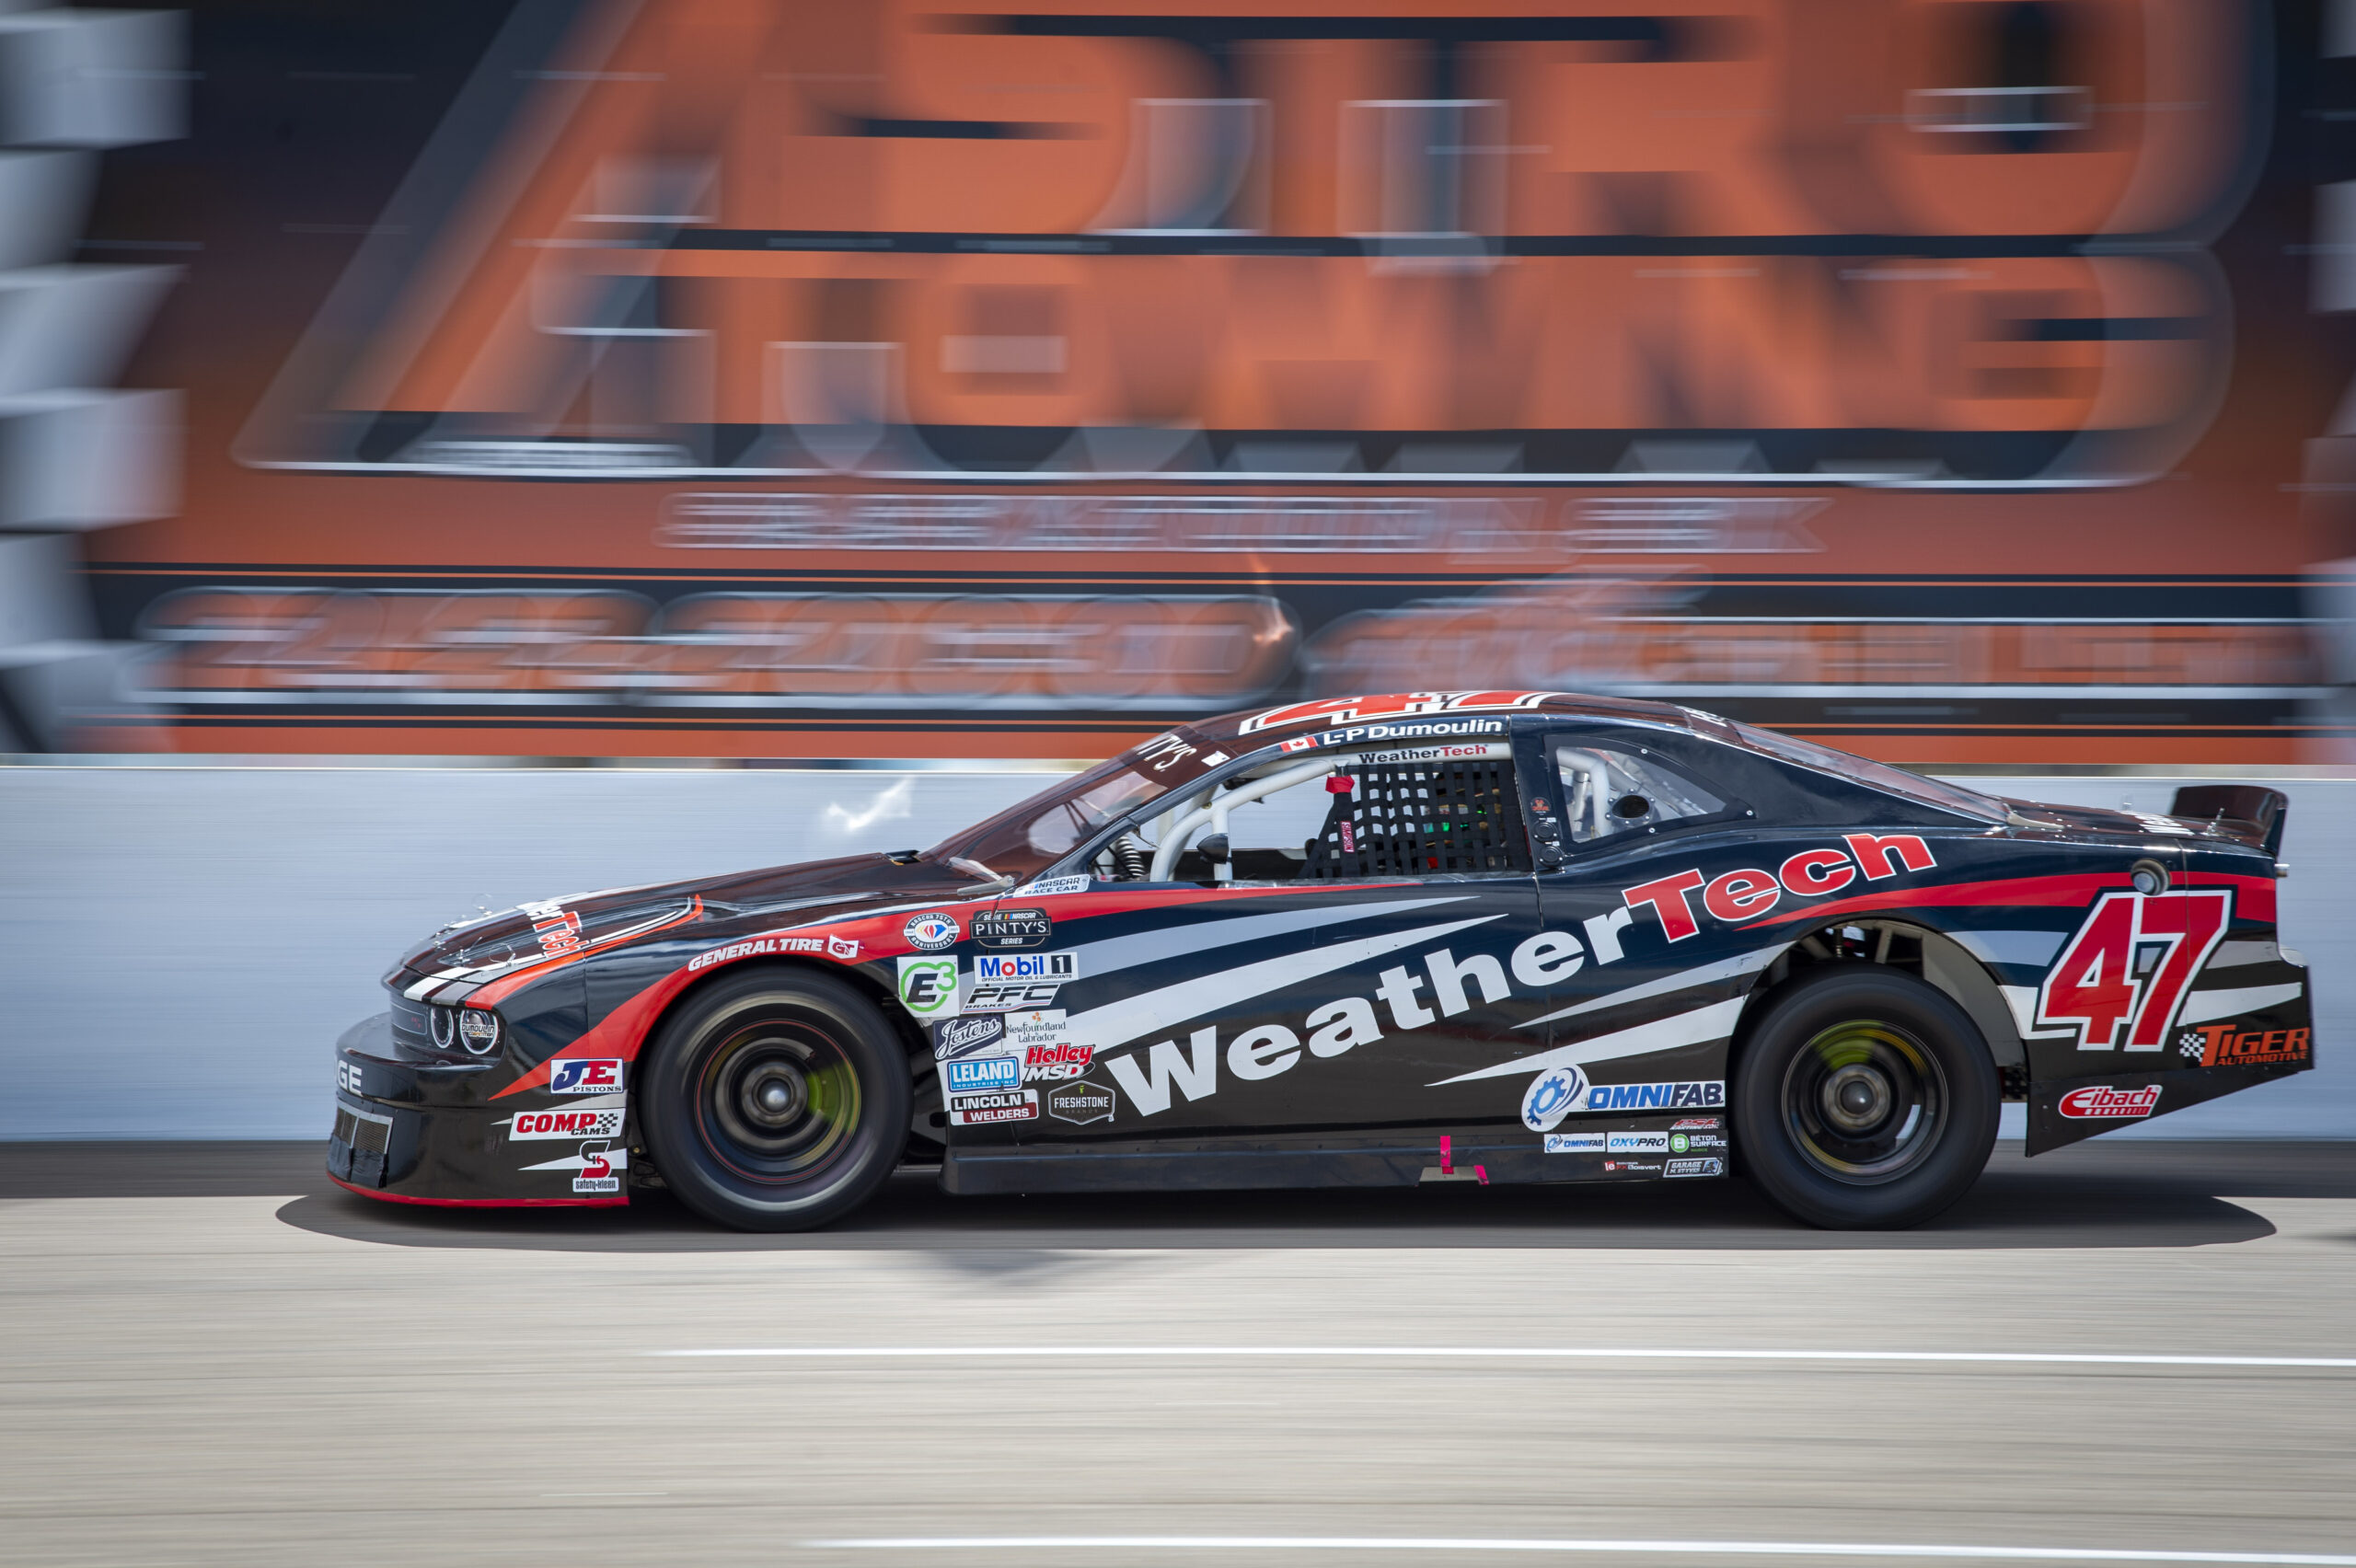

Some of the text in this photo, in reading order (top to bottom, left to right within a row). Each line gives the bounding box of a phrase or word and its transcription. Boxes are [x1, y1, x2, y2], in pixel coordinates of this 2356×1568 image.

[1368, 719, 1503, 737] Dumoulin
[1358, 744, 1487, 764] WeatherTech
[1341, 821, 1355, 853] SIMPSON
[1024, 887, 1053, 895] RACE
[1038, 877, 1080, 889] NASCAR
[910, 914, 934, 927] NASCAR
[1011, 912, 1036, 920] NASCAR
[976, 920, 1048, 936] PINTY'S
[911, 934, 954, 949] ANNIVERSARY
[687, 939, 777, 972] GENERAL
[779, 938, 825, 951] TIRE
[980, 955, 1045, 977] Mobil
[1104, 833, 1937, 1117] WeatherTech
[2036, 890, 2232, 1053] 47
[968, 984, 1060, 1004] PFC
[1007, 1021, 1067, 1034] Newfoundland
[934, 1019, 1002, 1060] Jostens
[1018, 1032, 1057, 1043] Labrador
[2196, 1024, 2310, 1067] TIGER
[1025, 1044, 1095, 1066] Holley
[2216, 1049, 2307, 1066] AUTOMOTIVE
[552, 1060, 618, 1091] JE
[953, 1061, 1015, 1083] LELAND
[1024, 1065, 1086, 1082] MSD
[953, 1093, 1022, 1111] LINCOLN
[1054, 1096, 1110, 1109] FRESHSTONE
[1588, 1083, 1724, 1110] OMNIFAB
[2061, 1088, 2159, 1119] Eibach
[516, 1113, 597, 1134] COMP
[969, 1107, 1030, 1122] WELDERS
[571, 1127, 611, 1136] CAMS
[1564, 1139, 1604, 1147] OMNIFAB
[1610, 1137, 1666, 1147] OXYPRO
